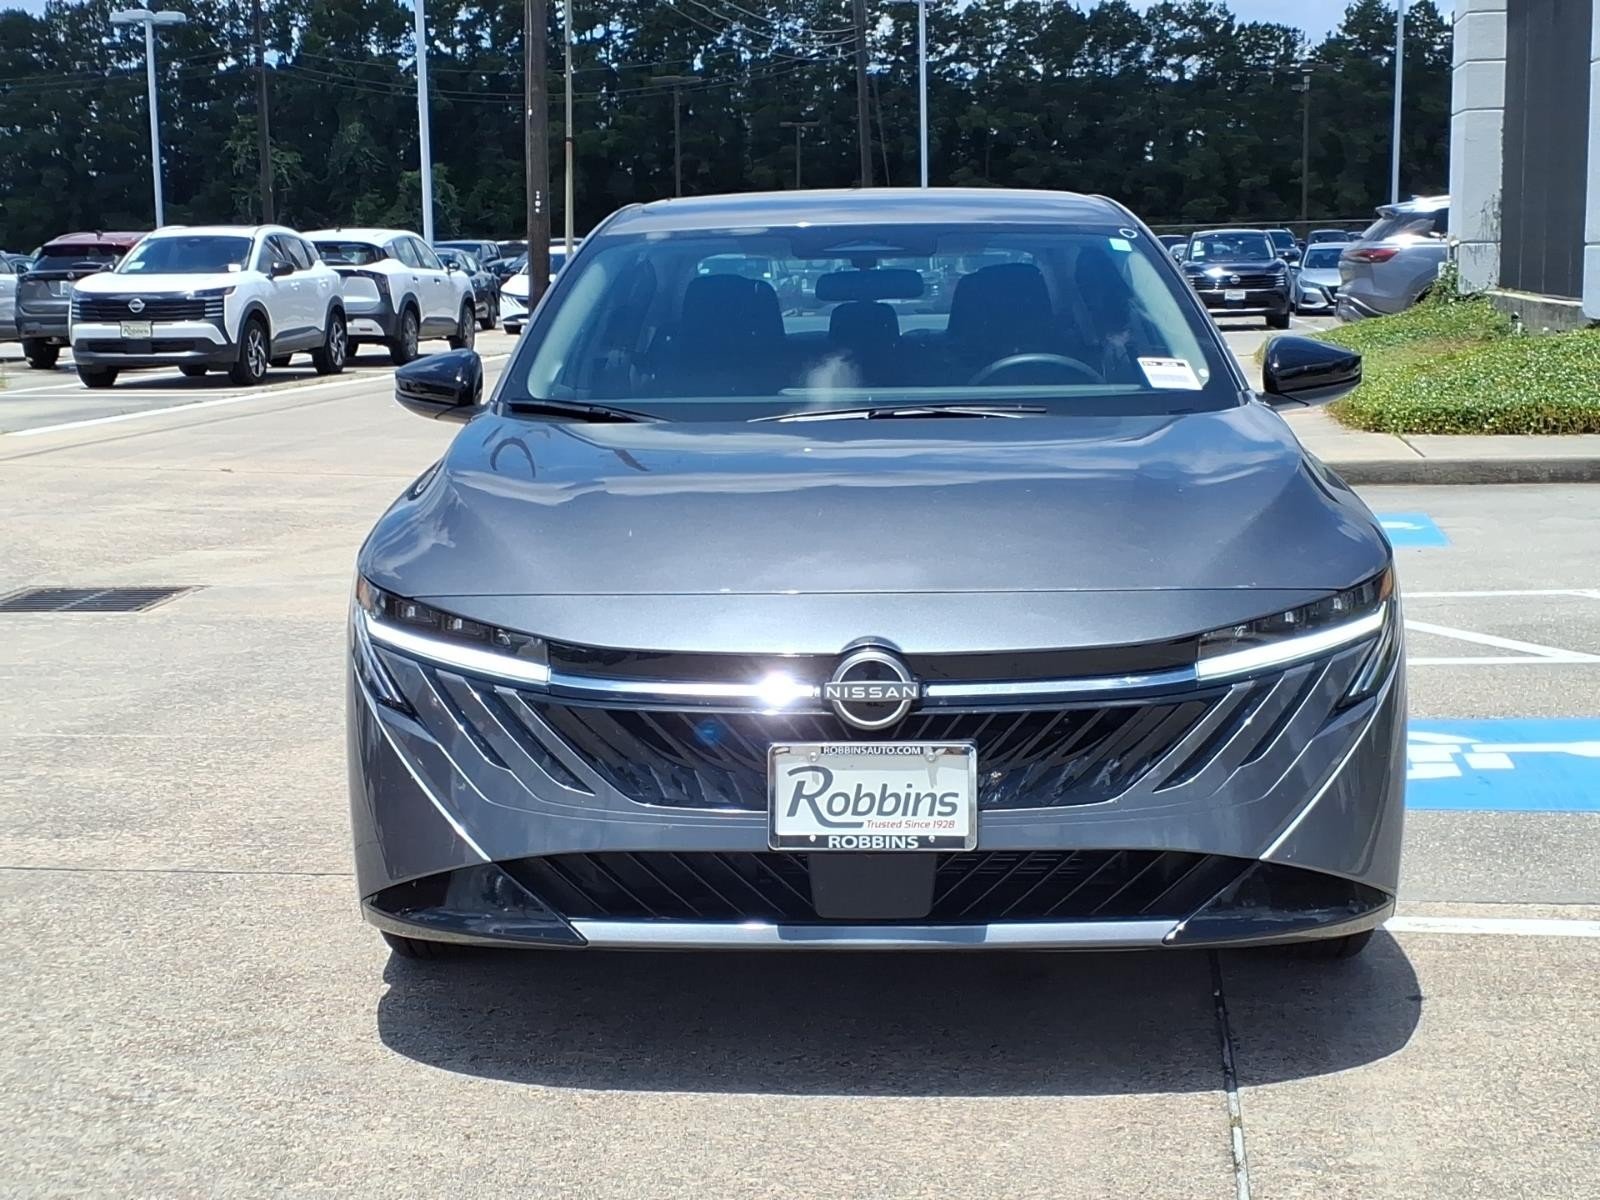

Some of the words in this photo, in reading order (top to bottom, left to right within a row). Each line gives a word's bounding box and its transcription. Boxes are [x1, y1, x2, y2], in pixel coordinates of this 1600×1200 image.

[826, 686, 917, 698] NISSAN
[823, 746, 921, 755] ROBBINSAUTO.COM
[786, 766, 959, 829] Robbins
[867, 820, 902, 829] Trusted
[905, 820, 931, 829] Since
[933, 820, 955, 829] 1928
[828, 835, 919, 849] ROBBINS
